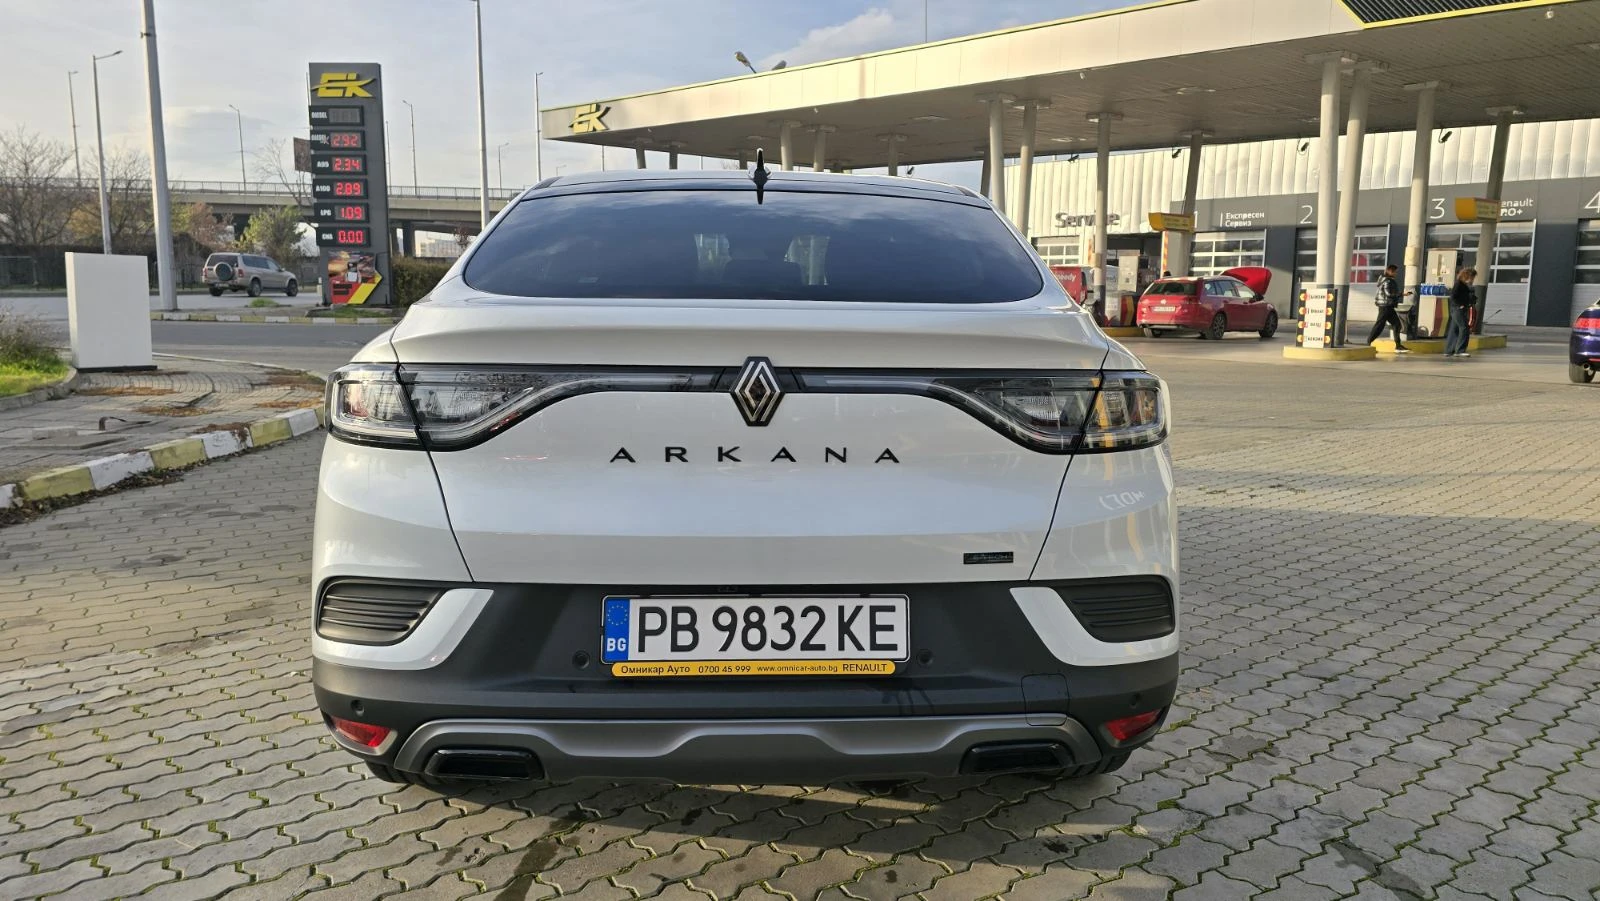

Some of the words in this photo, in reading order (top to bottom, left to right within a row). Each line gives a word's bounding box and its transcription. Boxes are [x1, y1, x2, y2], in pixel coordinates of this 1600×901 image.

[1429, 198, 1446, 220] 3
[1501, 198, 1534, 207] enault
[320, 209, 332, 217] LPG
[341, 206, 362, 219] 1.09
[1225, 211, 1265, 220] Експресен
[1300, 205, 1313, 224] 2
[1055, 212, 1120, 228] Serve
[1225, 219, 1252, 228] Сервиз
[338, 230, 363, 244] 0.00
[610, 446, 900, 463] ARKANA
[606, 637, 627, 652] BG
[637, 606, 700, 653] PB
[712, 605, 826, 652] 9832
[838, 605, 898, 651] KE
[621, 665, 664, 676] Омникар
[667, 665, 690, 676] Ауто
[698, 665, 719, 673] 0700
[722, 665, 733, 673] 45
[735, 665, 751, 673] 999
[757, 664, 838, 673] www.omnicar-auto.bg
[842, 663, 887, 672] RENAULT
